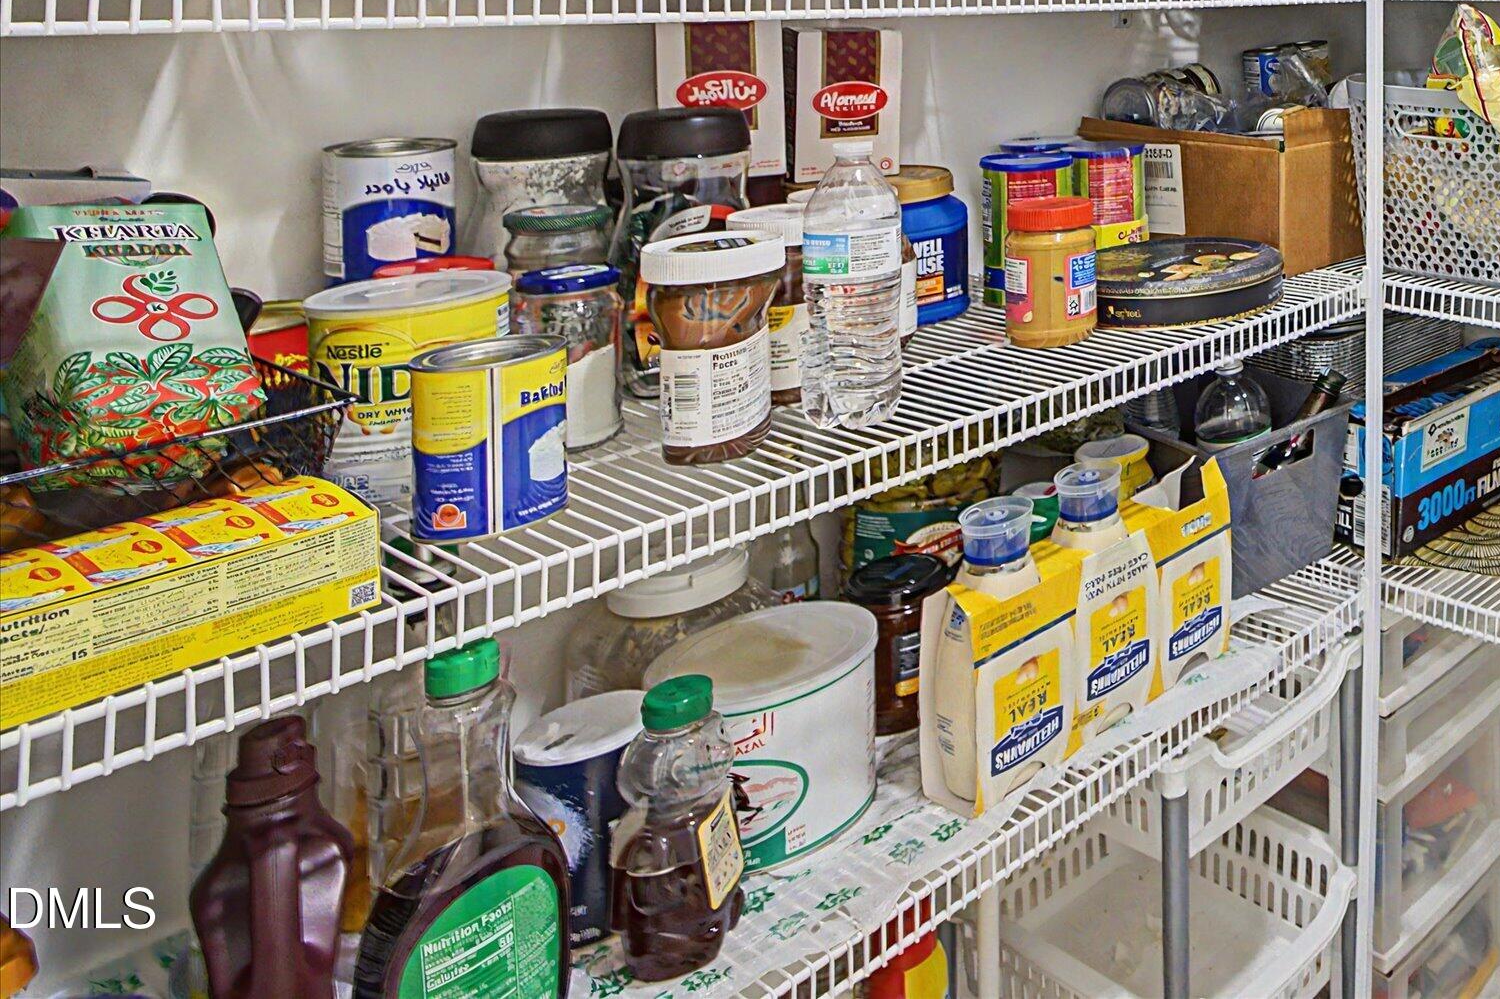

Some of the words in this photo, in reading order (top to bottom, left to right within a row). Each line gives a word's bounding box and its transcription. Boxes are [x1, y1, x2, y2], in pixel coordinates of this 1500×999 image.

[315, 361, 412, 405] NID
[357, 409, 382, 420] DRY
[0, 608, 70, 632] utrition
[1102, 624, 1136, 653] REAL
[1008, 689, 1047, 723] REAL
[423, 920, 480, 957] Nutrition
